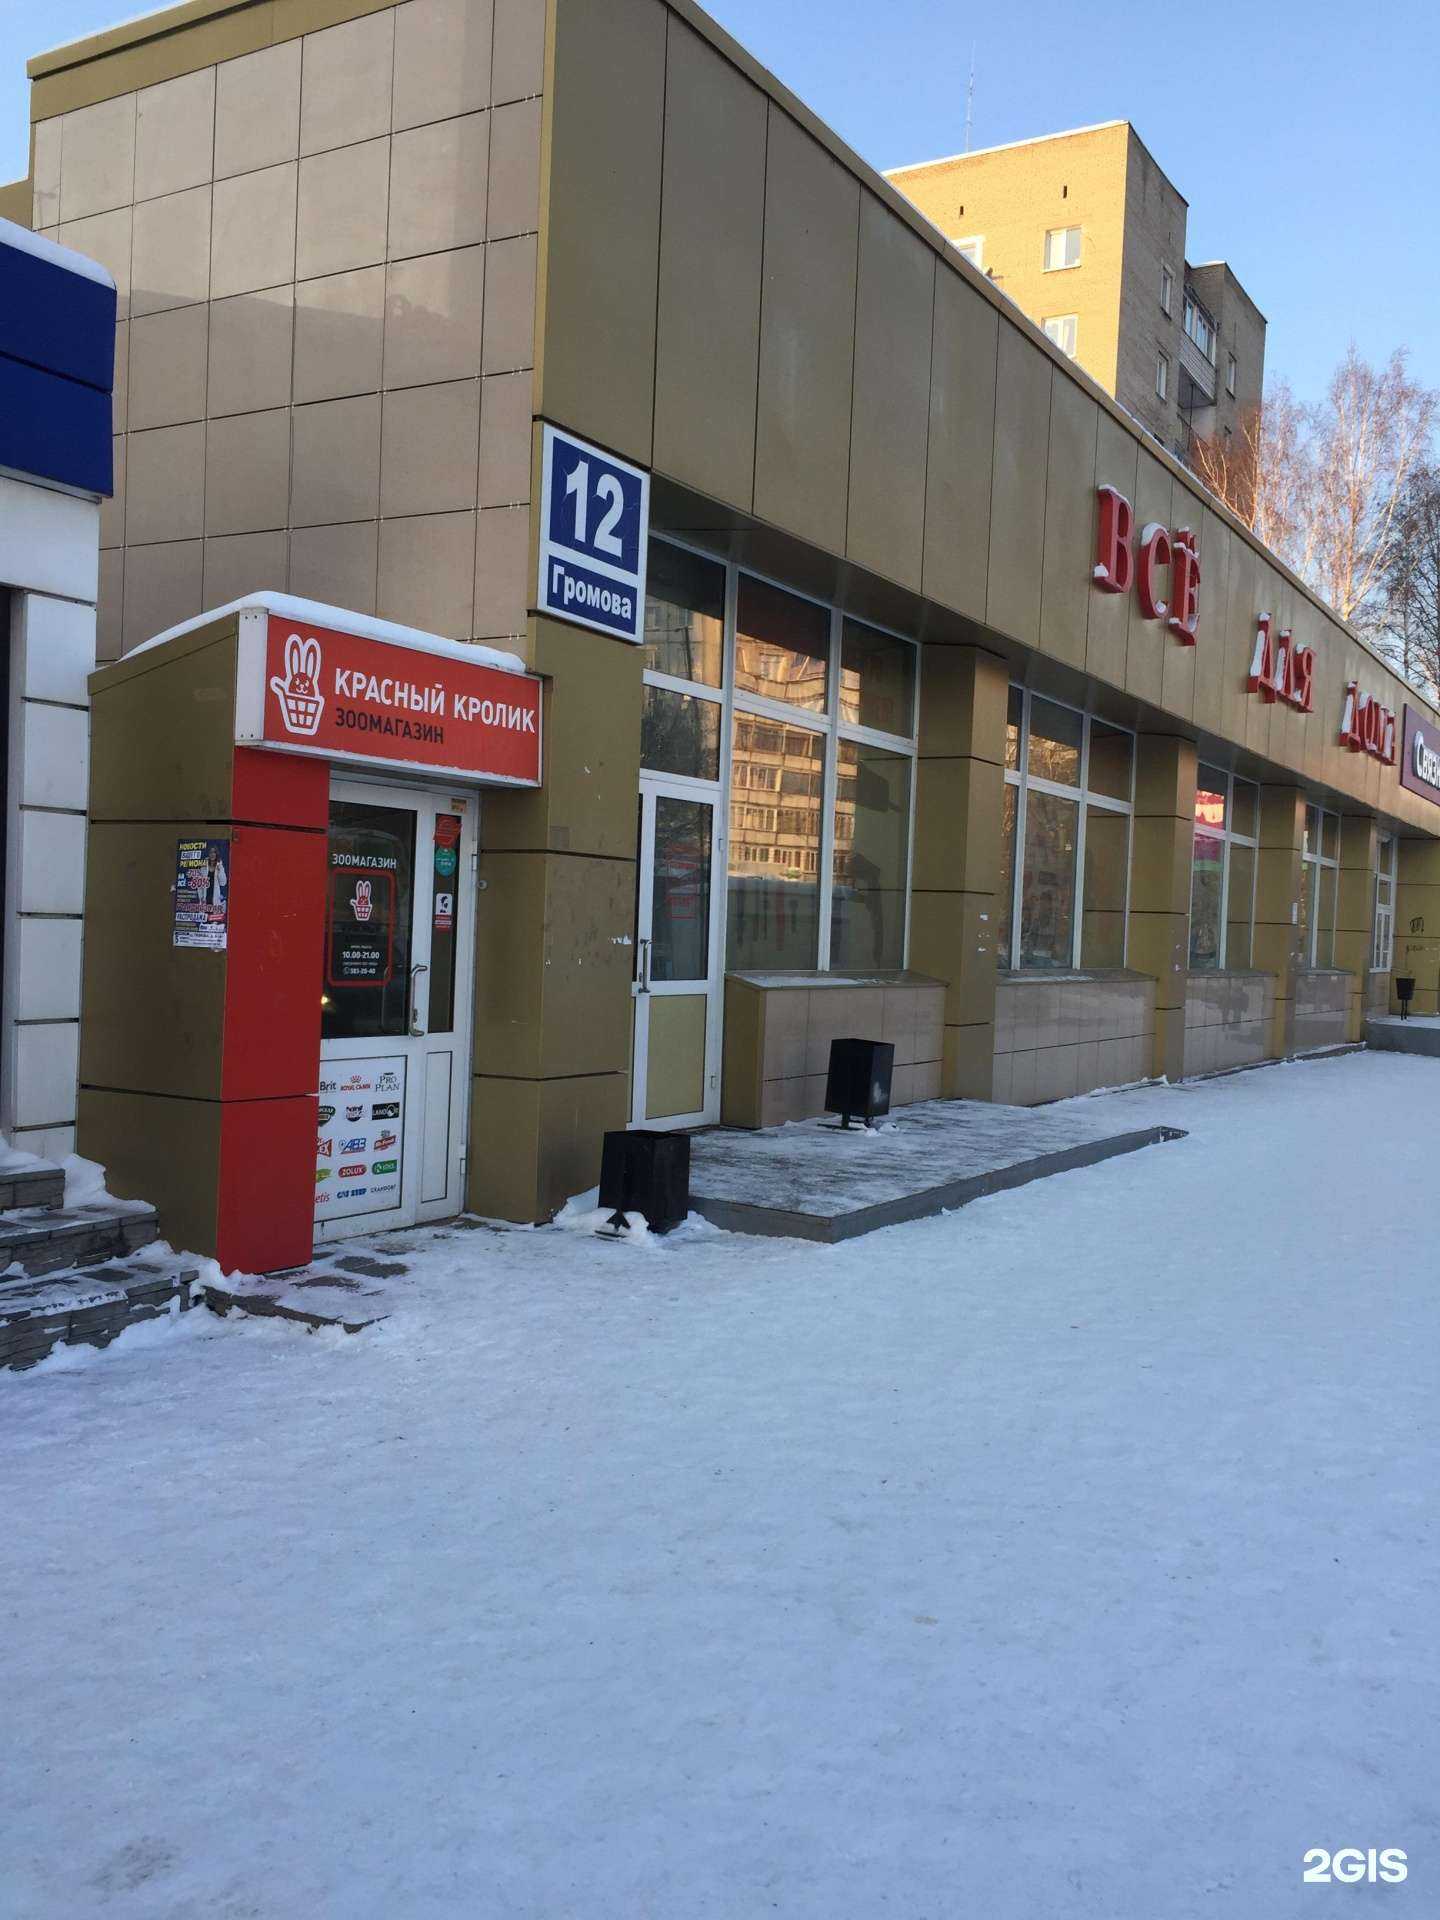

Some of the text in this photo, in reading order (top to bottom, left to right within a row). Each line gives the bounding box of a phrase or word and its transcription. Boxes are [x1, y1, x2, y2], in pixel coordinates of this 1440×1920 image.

[565, 459, 625, 559] 12
[552, 563, 633, 620] Громова
[1093, 484, 1200, 647] ВСЁ
[1247, 611, 1318, 713] ДЛЯ
[334, 667, 536, 734] КРАСНЫЙ КРОЛИК
[335, 708, 445, 745] ЗООМАГАЗИН
[332, 853, 397, 869] ЗООМАГАЗИН
[320, 1080, 337, 1092] Brit
[341, 1166, 364, 1177] ZOLUX
